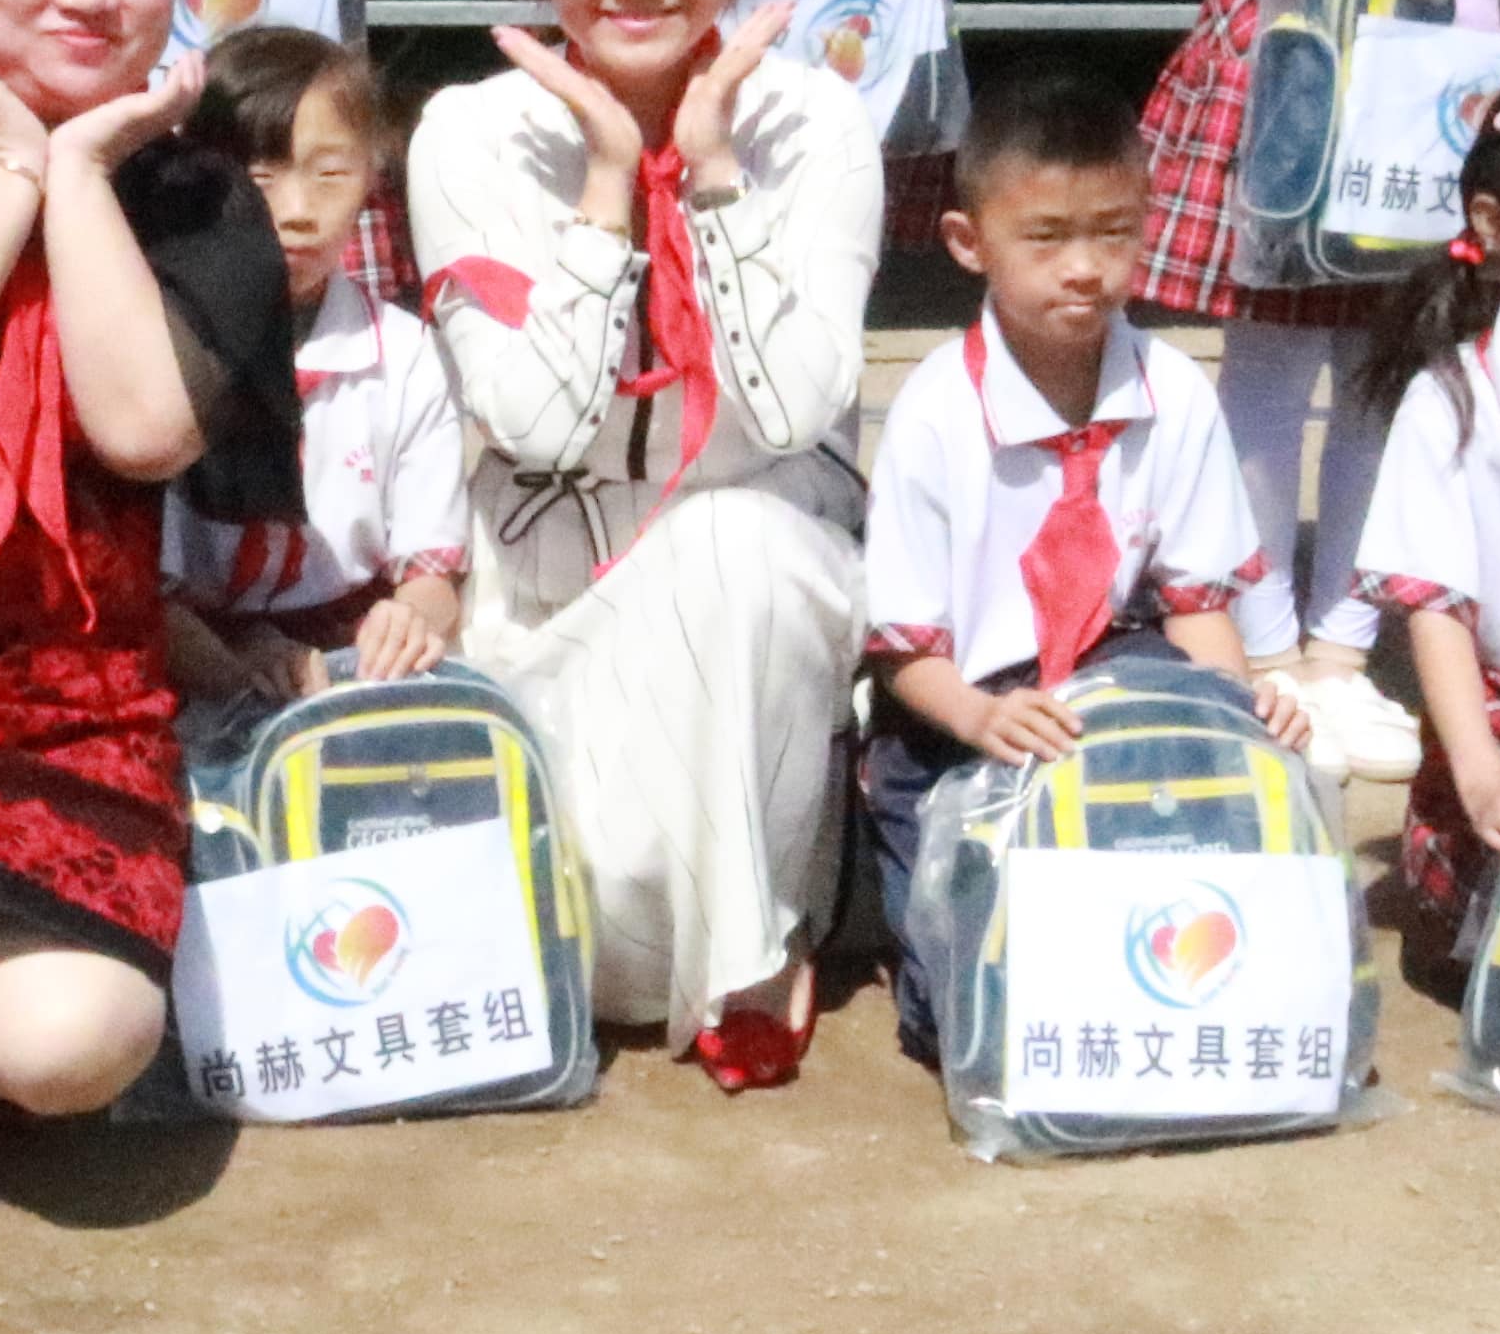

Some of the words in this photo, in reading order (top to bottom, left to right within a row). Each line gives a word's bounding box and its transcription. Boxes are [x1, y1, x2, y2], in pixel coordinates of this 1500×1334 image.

[201, 986, 534, 1100] 尚赫文具套组
[1022, 1019, 1335, 1081] 尚赫文具套组
